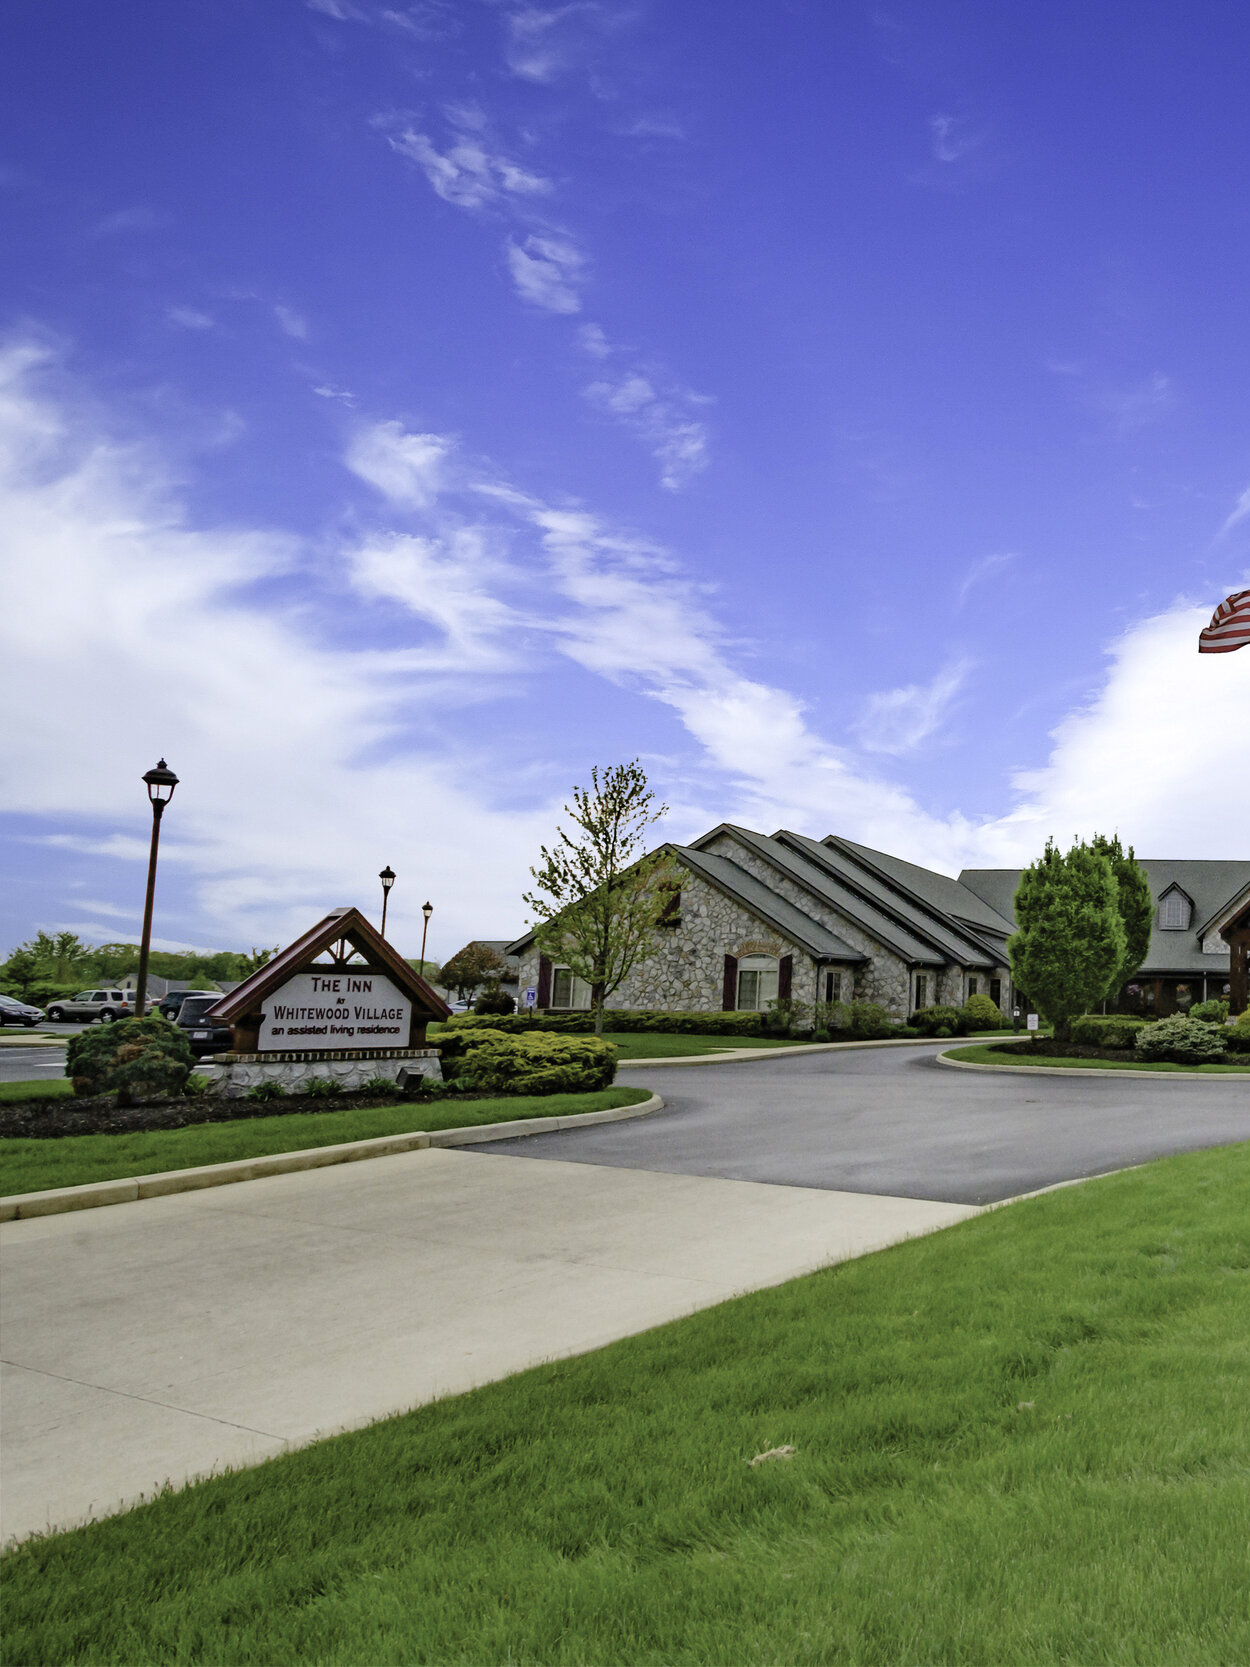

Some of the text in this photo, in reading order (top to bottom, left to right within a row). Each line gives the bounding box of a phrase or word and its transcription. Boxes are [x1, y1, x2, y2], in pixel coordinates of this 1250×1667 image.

[274, 1006, 403, 1020] WHITEWOOD VILLAGE
[271, 1024, 400, 1037] an assisted living residence
